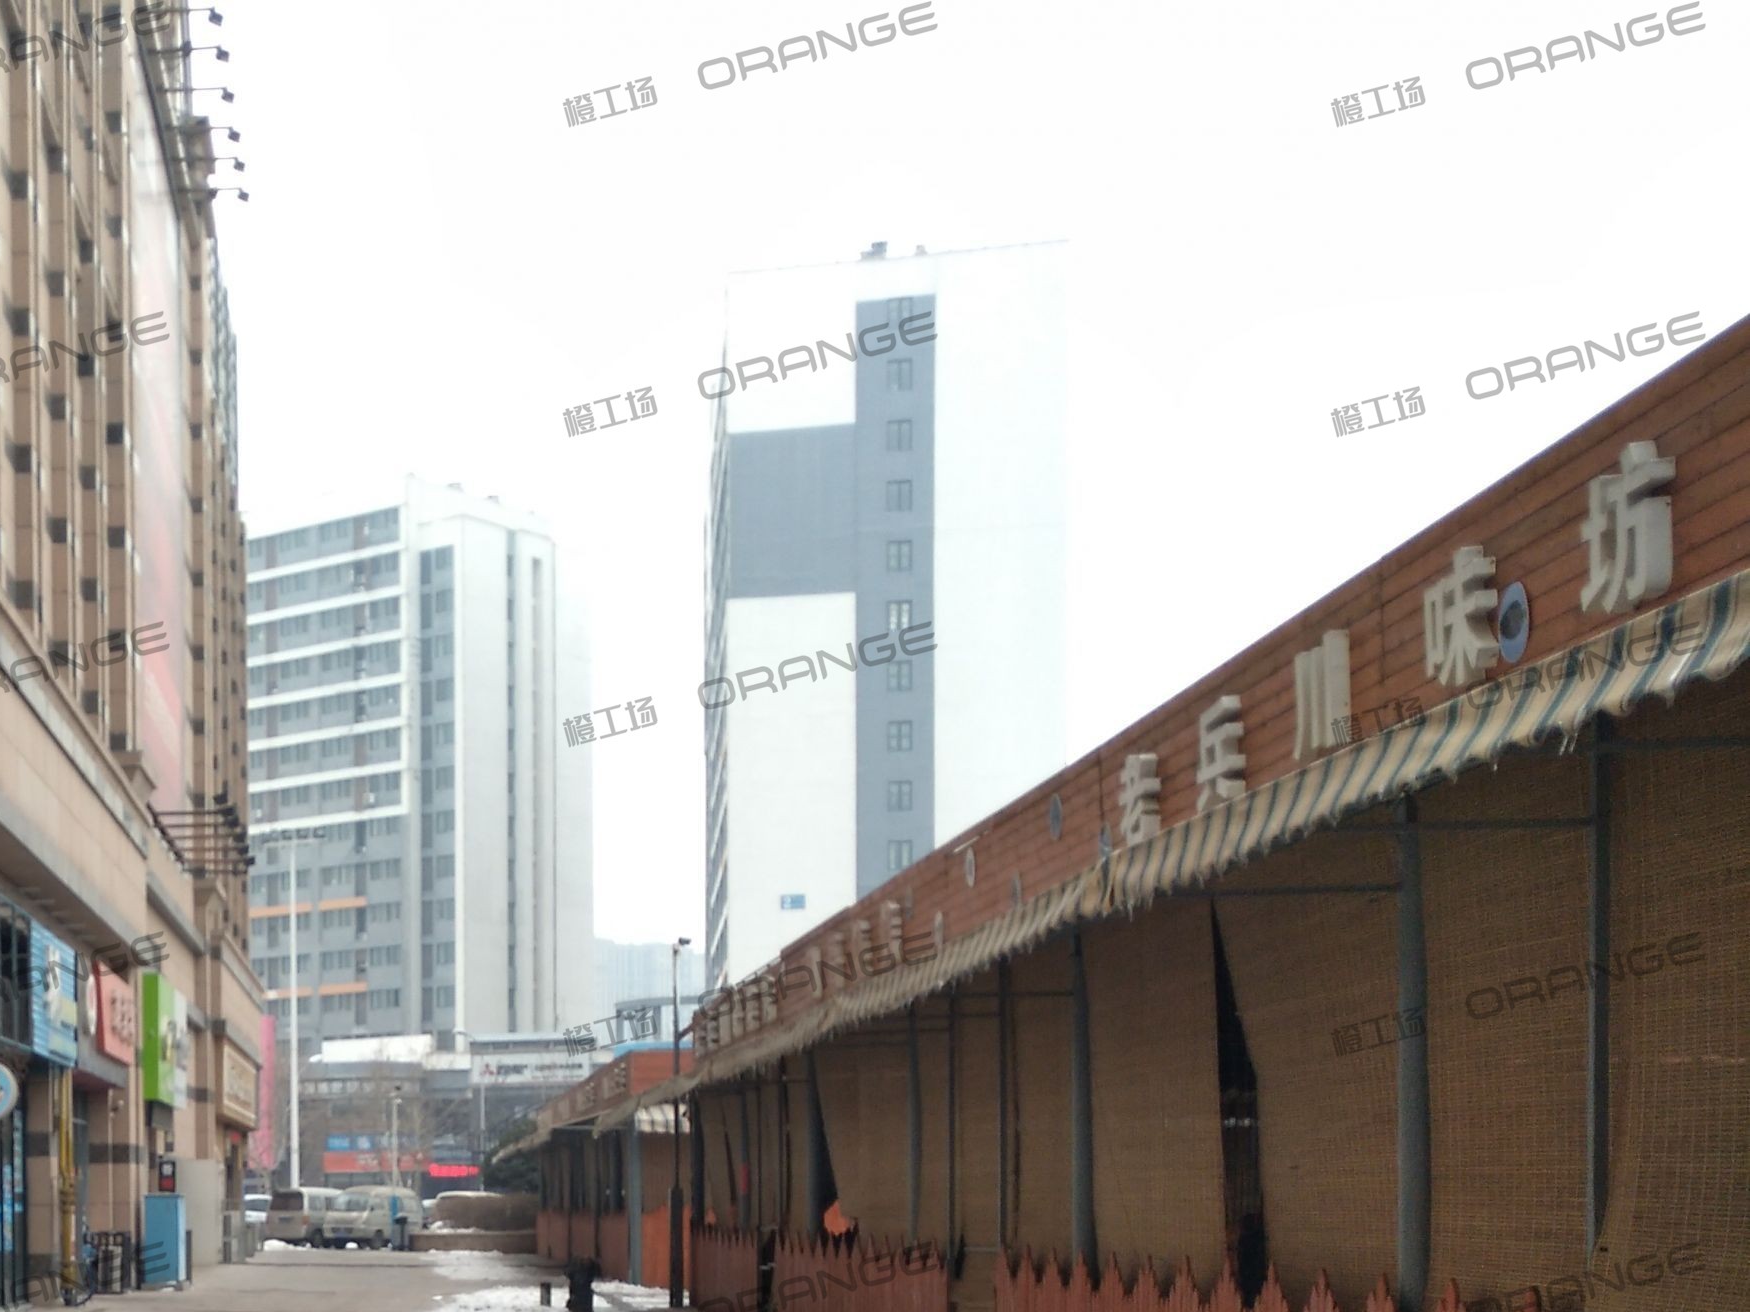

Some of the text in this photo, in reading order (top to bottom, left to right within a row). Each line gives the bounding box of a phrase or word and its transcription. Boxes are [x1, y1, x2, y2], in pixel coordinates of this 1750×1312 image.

[1119, 440, 1676, 846] 老兵川味坊
